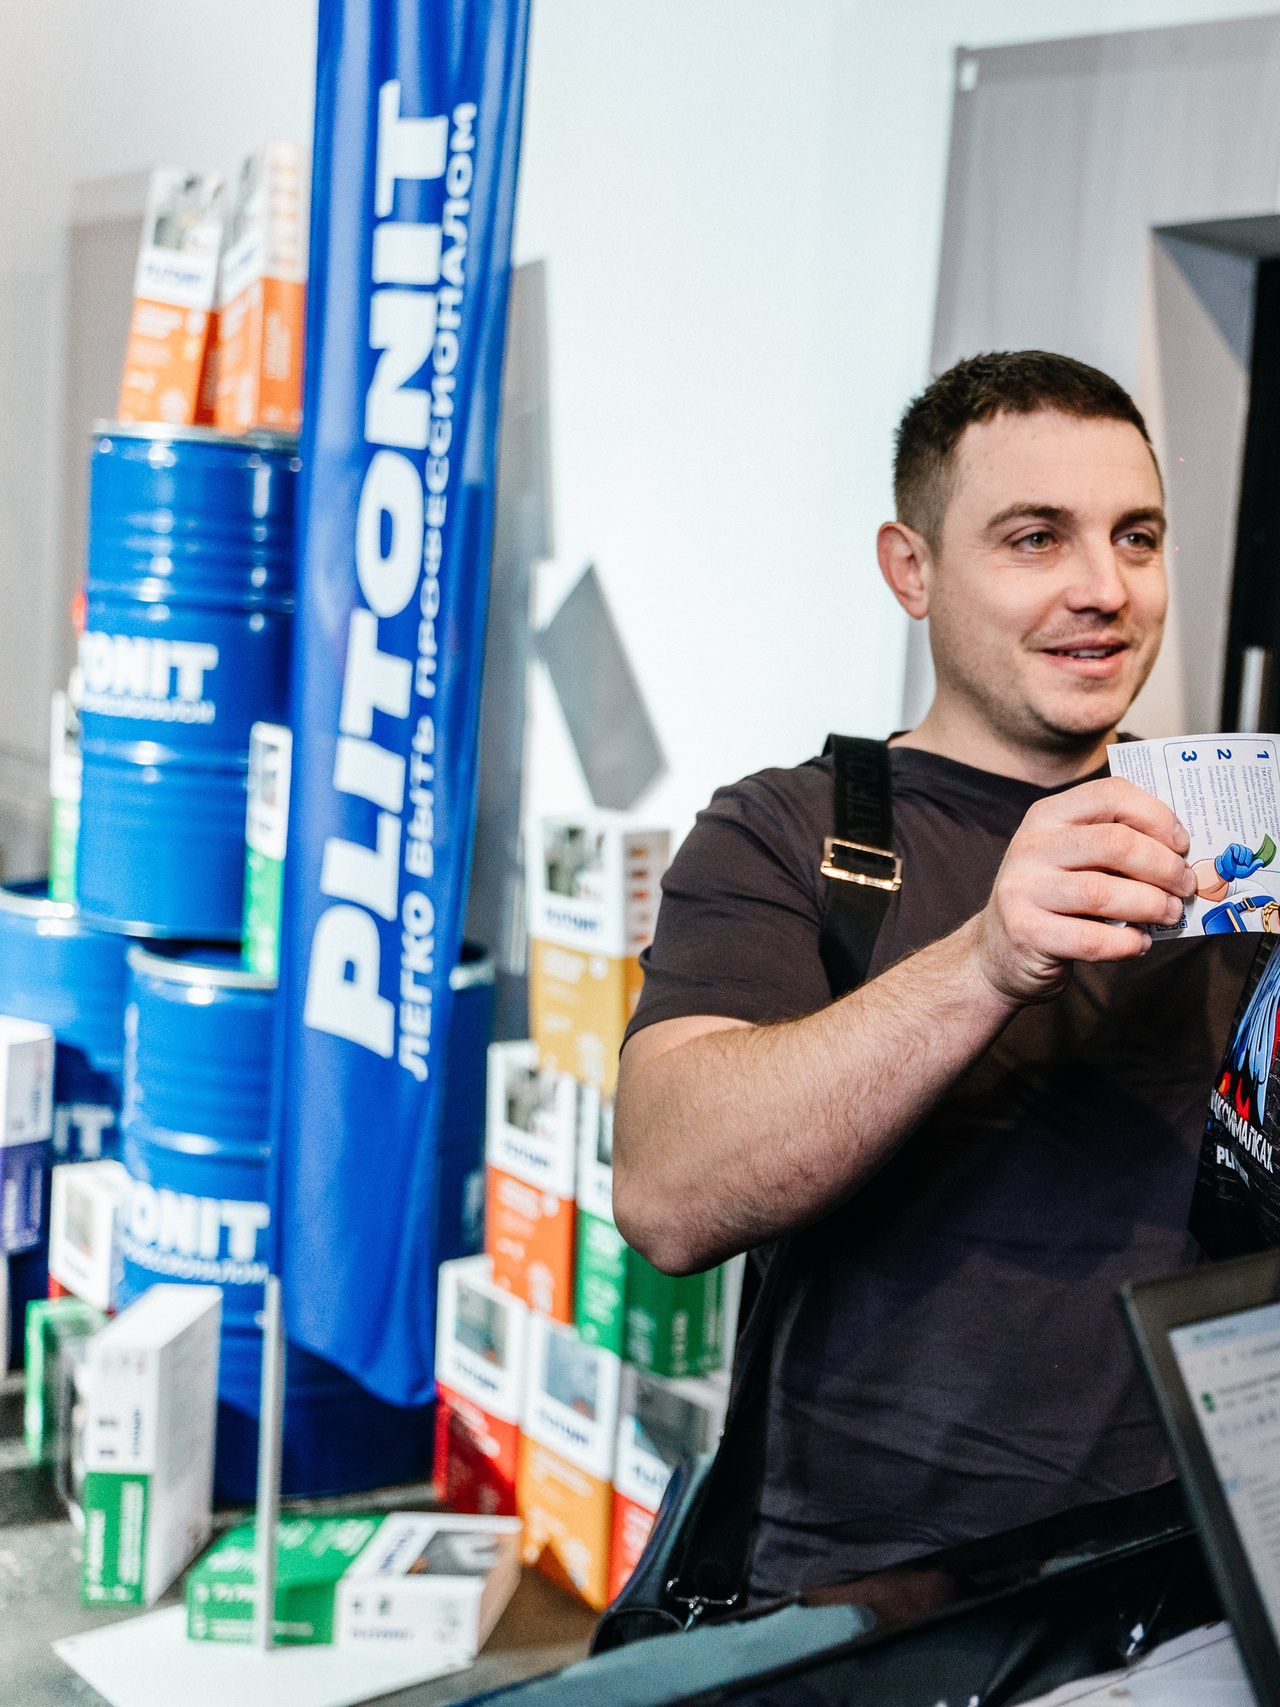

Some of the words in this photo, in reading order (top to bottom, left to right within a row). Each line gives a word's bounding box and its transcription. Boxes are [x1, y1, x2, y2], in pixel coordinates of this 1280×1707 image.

[414, 102, 477, 698] ПРОФЕССИОНАЛОМ
[303, 79, 448, 1059] PLITONIT
[405, 715, 435, 878] БЫТЬ
[1181, 750, 1197, 762] 3
[1217, 749, 1232, 759] 2
[1257, 750, 1269, 759] 1
[398, 890, 435, 1082] ЛЕГКО
